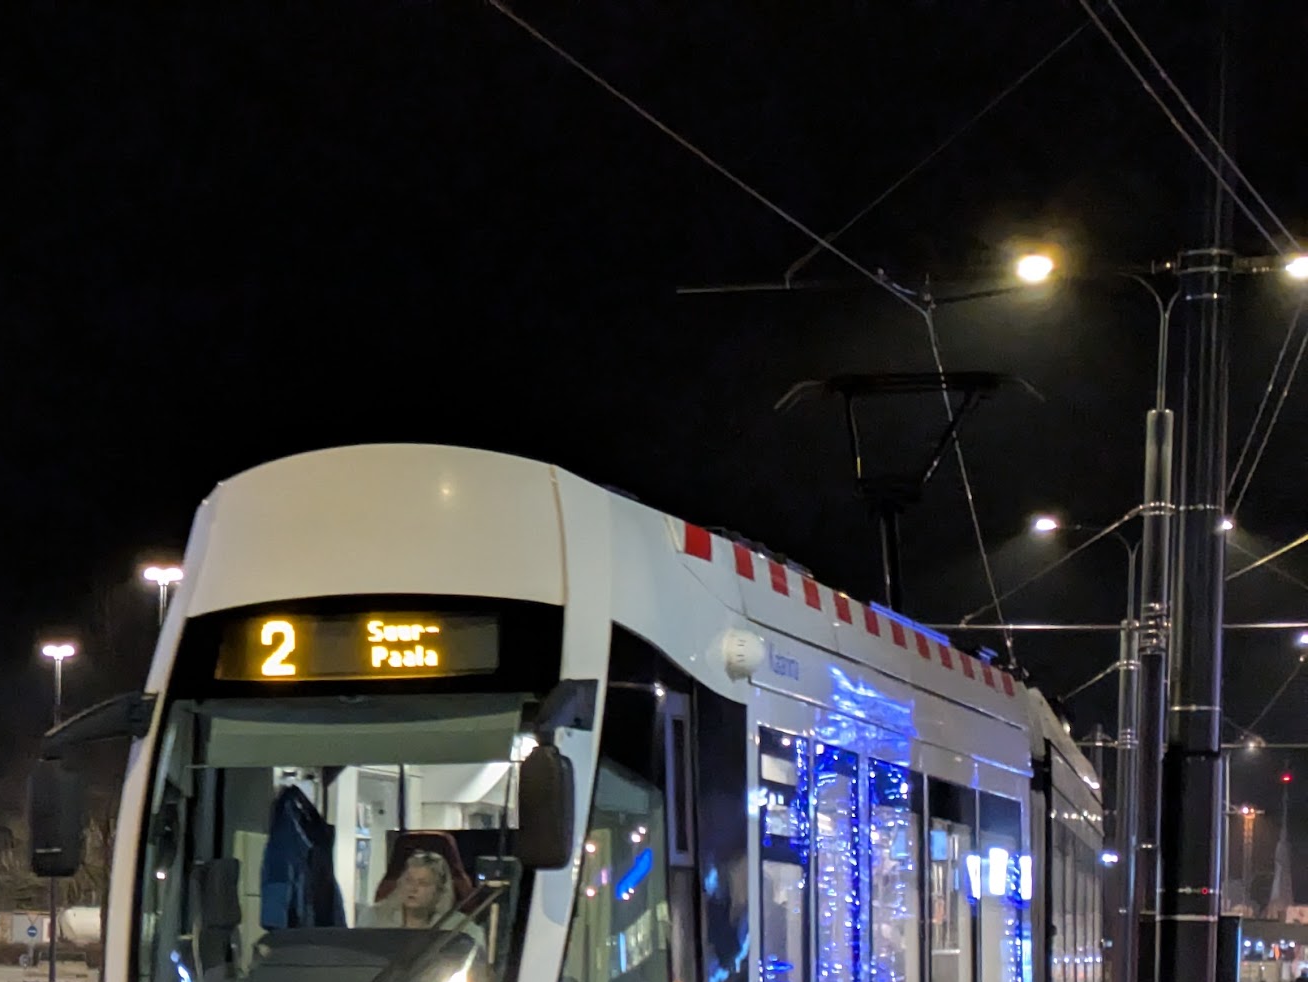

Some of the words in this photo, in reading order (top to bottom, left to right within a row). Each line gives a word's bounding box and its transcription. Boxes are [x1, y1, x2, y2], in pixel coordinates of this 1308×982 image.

[367, 620, 440, 642] Suur-
[260, 620, 296, 676] 2
[371, 645, 439, 668] Paala
